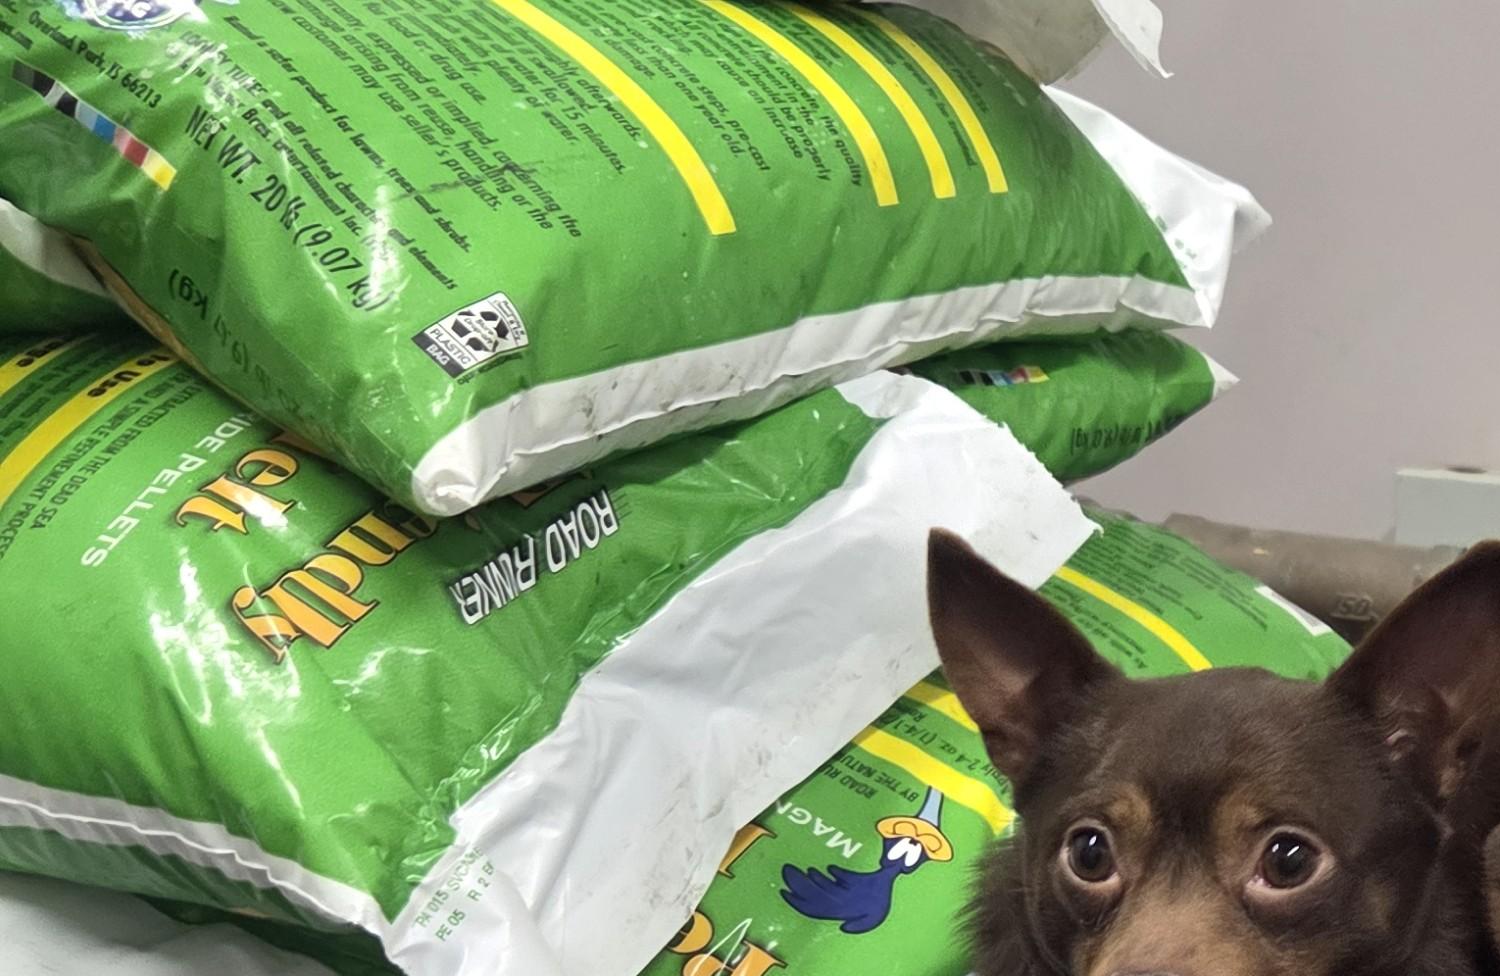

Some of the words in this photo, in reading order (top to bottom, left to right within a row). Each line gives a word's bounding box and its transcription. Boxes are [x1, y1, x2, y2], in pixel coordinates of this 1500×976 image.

[73, 40, 105, 72] Park,
[121, 73, 161, 108] 66213
[430, 54, 464, 81] drug
[529, 52, 598, 113] swallowed.
[292, 17, 354, 61] customer
[349, 60, 383, 89] may
[378, 92, 405, 112] use
[400, 114, 450, 157] seller's
[440, 159, 502, 211] products.
[342, 35, 390, 72] arising
[386, 73, 421, 102] from
[417, 104, 456, 140] reuse,
[455, 140, 515, 194] handling
[526, 204, 556, 232] the
[484, 60, 528, 94] plenty
[541, 111, 579, 145] water.
[506, 51, 544, 85] water
[539, 83, 566, 106] for
[561, 106, 584, 120] 15
[576, 123, 625, 175] minutes.
[577, 79, 641, 141] afterwards.
[647, 57, 676, 79] than
[674, 81, 699, 102] one
[694, 104, 725, 130] year
[721, 134, 746, 158] old.
[651, 45, 700, 84] concrete
[697, 86, 729, 117] steps,
[725, 120, 771, 171] pre-cast
[716, 54, 750, 87] cause
[748, 90, 766, 104] an
[763, 107, 803, 159] increase
[743, 63, 787, 104] should
[780, 107, 797, 121] be
[791, 126, 831, 181] properly
[265, 49, 298, 79] safer
[290, 76, 338, 114] product
[331, 112, 357, 135] for
[349, 133, 384, 168] lawns,
[386, 168, 416, 197] trees
[414, 195, 441, 215] and
[434, 217, 470, 252] shrubs.
[366, 33, 436, 90] expressed
[442, 100, 498, 149] implied,
[558, 214, 582, 238] the
[835, 140, 863, 187] quality
[185, 105, 227, 152] NET
[210, 135, 262, 184] WT.
[250, 174, 287, 212] 20
[293, 223, 364, 274] (9.07
[242, 108, 271, 142] Bros.
[341, 215, 362, 236] Inc.
[261, 99, 291, 120] and
[283, 121, 307, 136] all
[298, 138, 342, 180] related
[334, 181, 386, 228] characte
[387, 225, 416, 249] and
[409, 247, 457, 290] elements
[88, 361, 141, 397] Use
[426, 344, 450, 366] BAG
[430, 328, 472, 365] PLASTIC
[78, 451, 110, 482] THE
[102, 428, 141, 461] FROM
[50, 471, 87, 510] DEAD
[81, 453, 208, 568] PELLETS
[176, 430, 325, 536] elt
[30, 507, 58, 529] SEA
[545, 489, 621, 574] ROAD
[448, 533, 539, 626] RUNNER
[839, 755, 878, 780] NATU
[840, 775, 877, 799] ROAD
[874, 772, 901, 792] THE
[899, 788, 919, 802] BY
[955, 754, 981, 771] 2-4
[427, 890, 449, 912] 015
[435, 924, 452, 942] PE
[448, 909, 466, 926] 05
